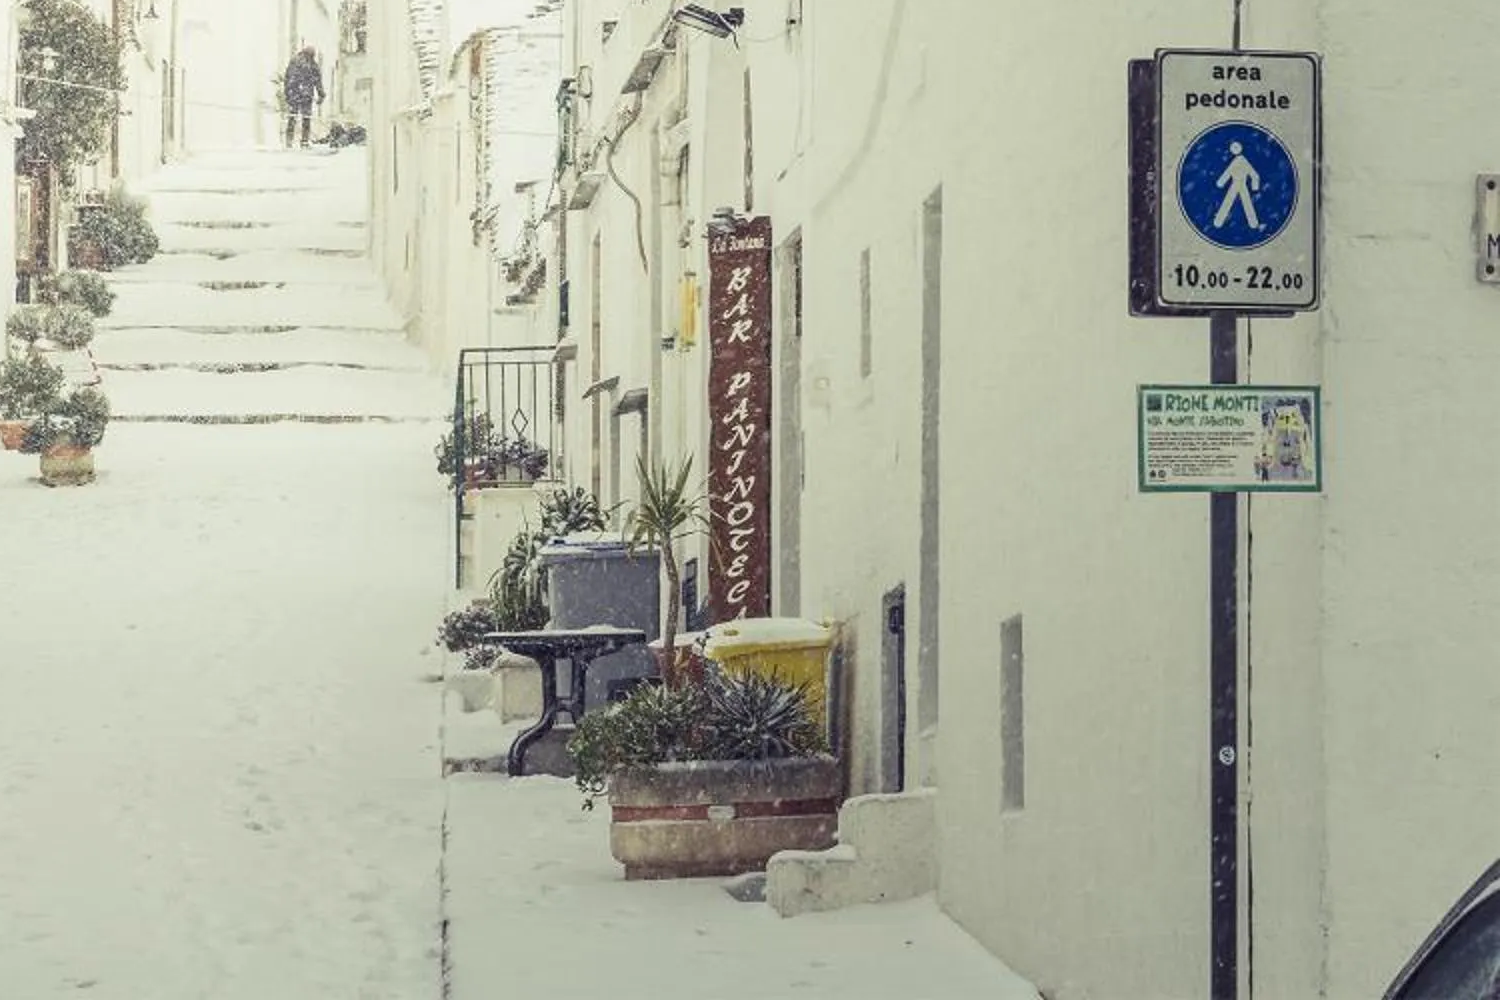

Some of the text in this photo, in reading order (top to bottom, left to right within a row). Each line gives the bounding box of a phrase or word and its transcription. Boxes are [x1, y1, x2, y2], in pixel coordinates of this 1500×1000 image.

[1212, 66, 1261, 81] area
[1185, 89, 1291, 110] pedonale
[723, 266, 752, 344] BAR
[1165, 394, 1260, 412] RIONE MONTI
